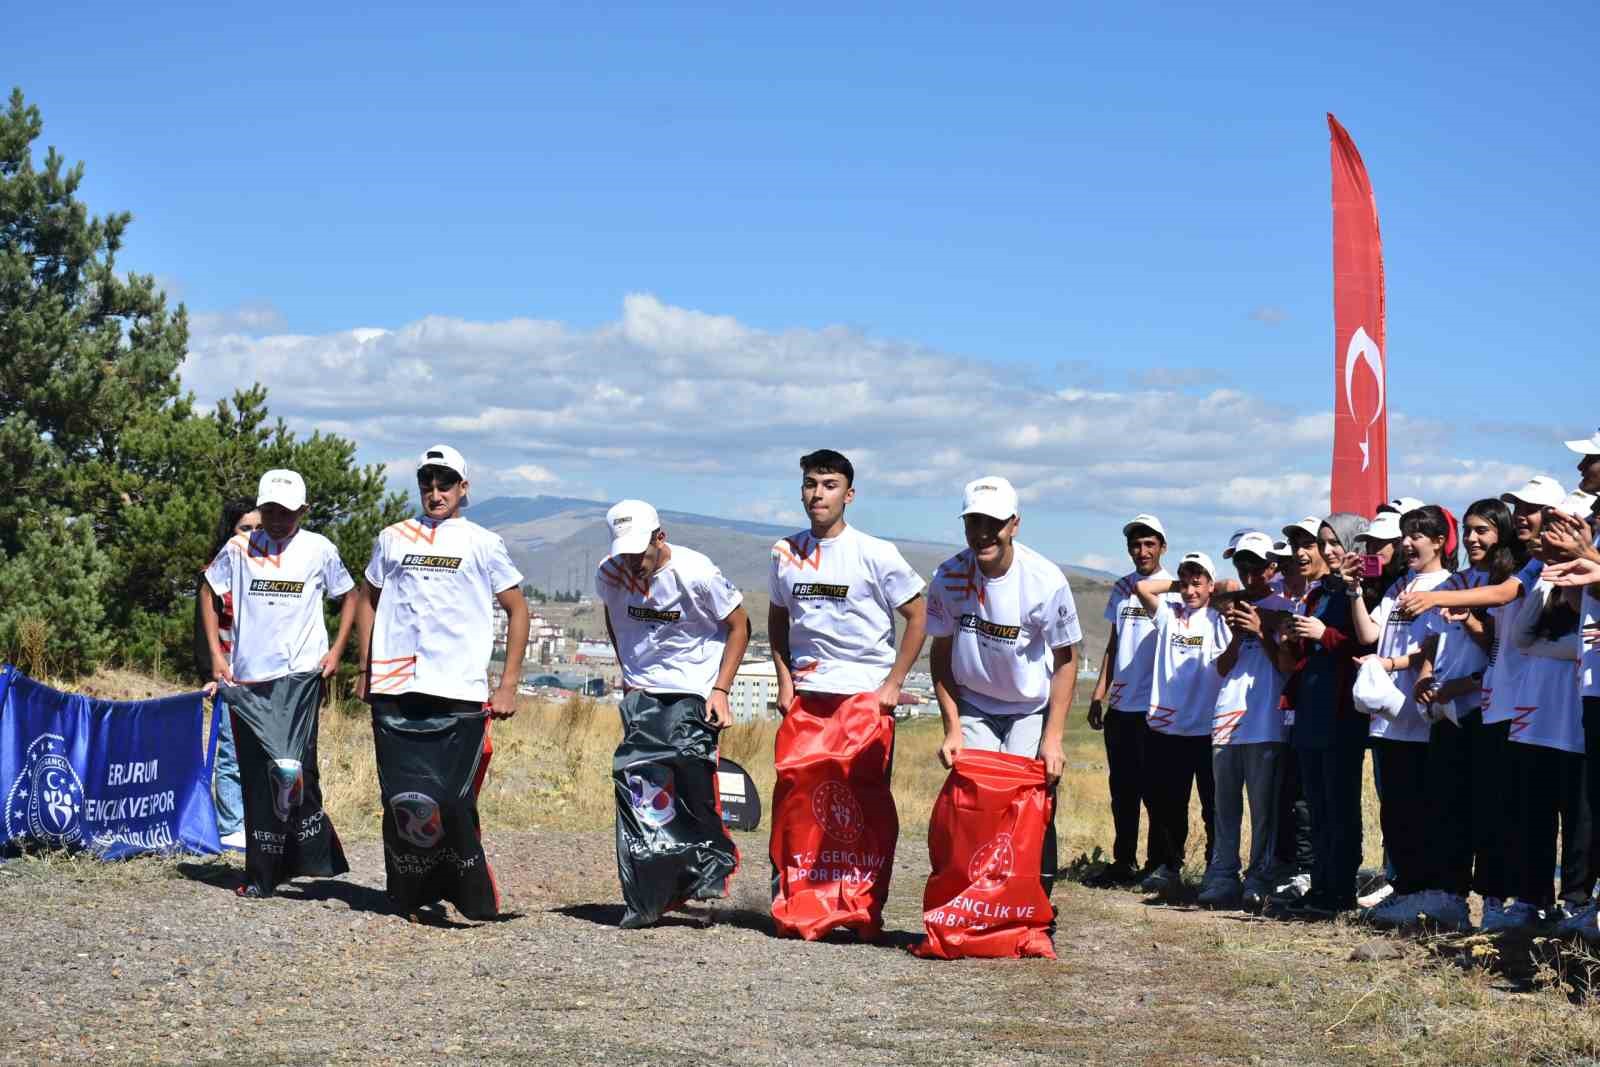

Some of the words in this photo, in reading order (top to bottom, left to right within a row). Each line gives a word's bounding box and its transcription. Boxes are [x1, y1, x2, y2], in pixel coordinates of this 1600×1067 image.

[403, 555, 460, 567] #BEACTIVE
[252, 581, 303, 592] #BEACTIVE
[794, 585, 848, 597] #BEACTIVE
[129, 797, 149, 818] VE
[1016, 905, 1035, 918] VE
